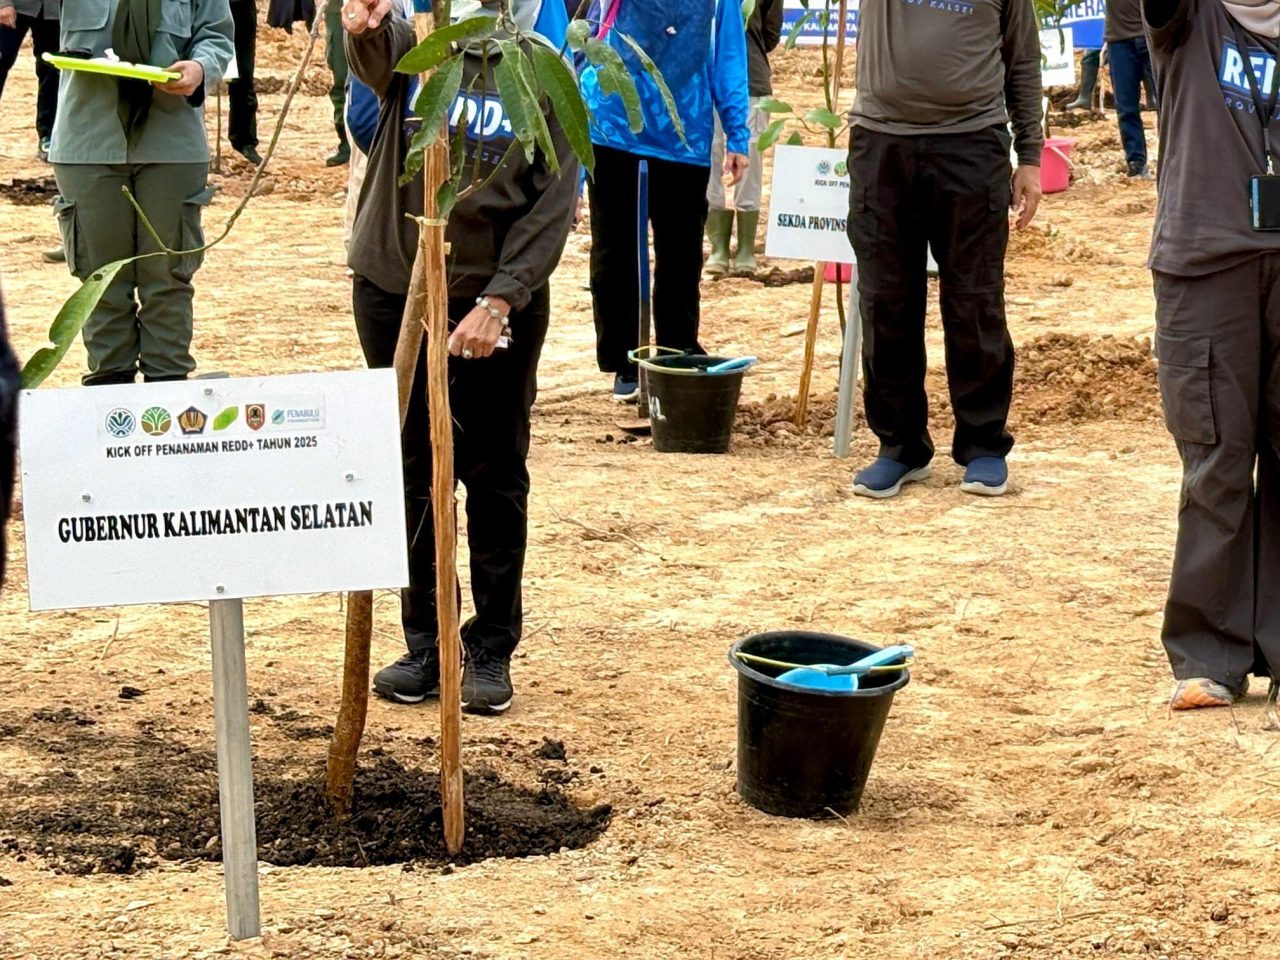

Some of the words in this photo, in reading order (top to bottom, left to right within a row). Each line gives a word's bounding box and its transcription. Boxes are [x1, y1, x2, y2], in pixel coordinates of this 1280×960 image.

[1225, 95, 1255, 114] ROV
[777, 213, 806, 229] SEKDA
[287, 408, 320, 418] PENABULU
[106, 445, 131, 458] KICK
[134, 444, 152, 456] OFF
[156, 441, 219, 455] PENANAMAN
[222, 439, 253, 453] REDD+
[258, 437, 291, 450] TAHUN
[294, 435, 318, 448] 2025
[58, 513, 159, 543] GUBERNUR
[163, 506, 287, 538] KALIMANTAN
[290, 500, 373, 531] SELATAN
